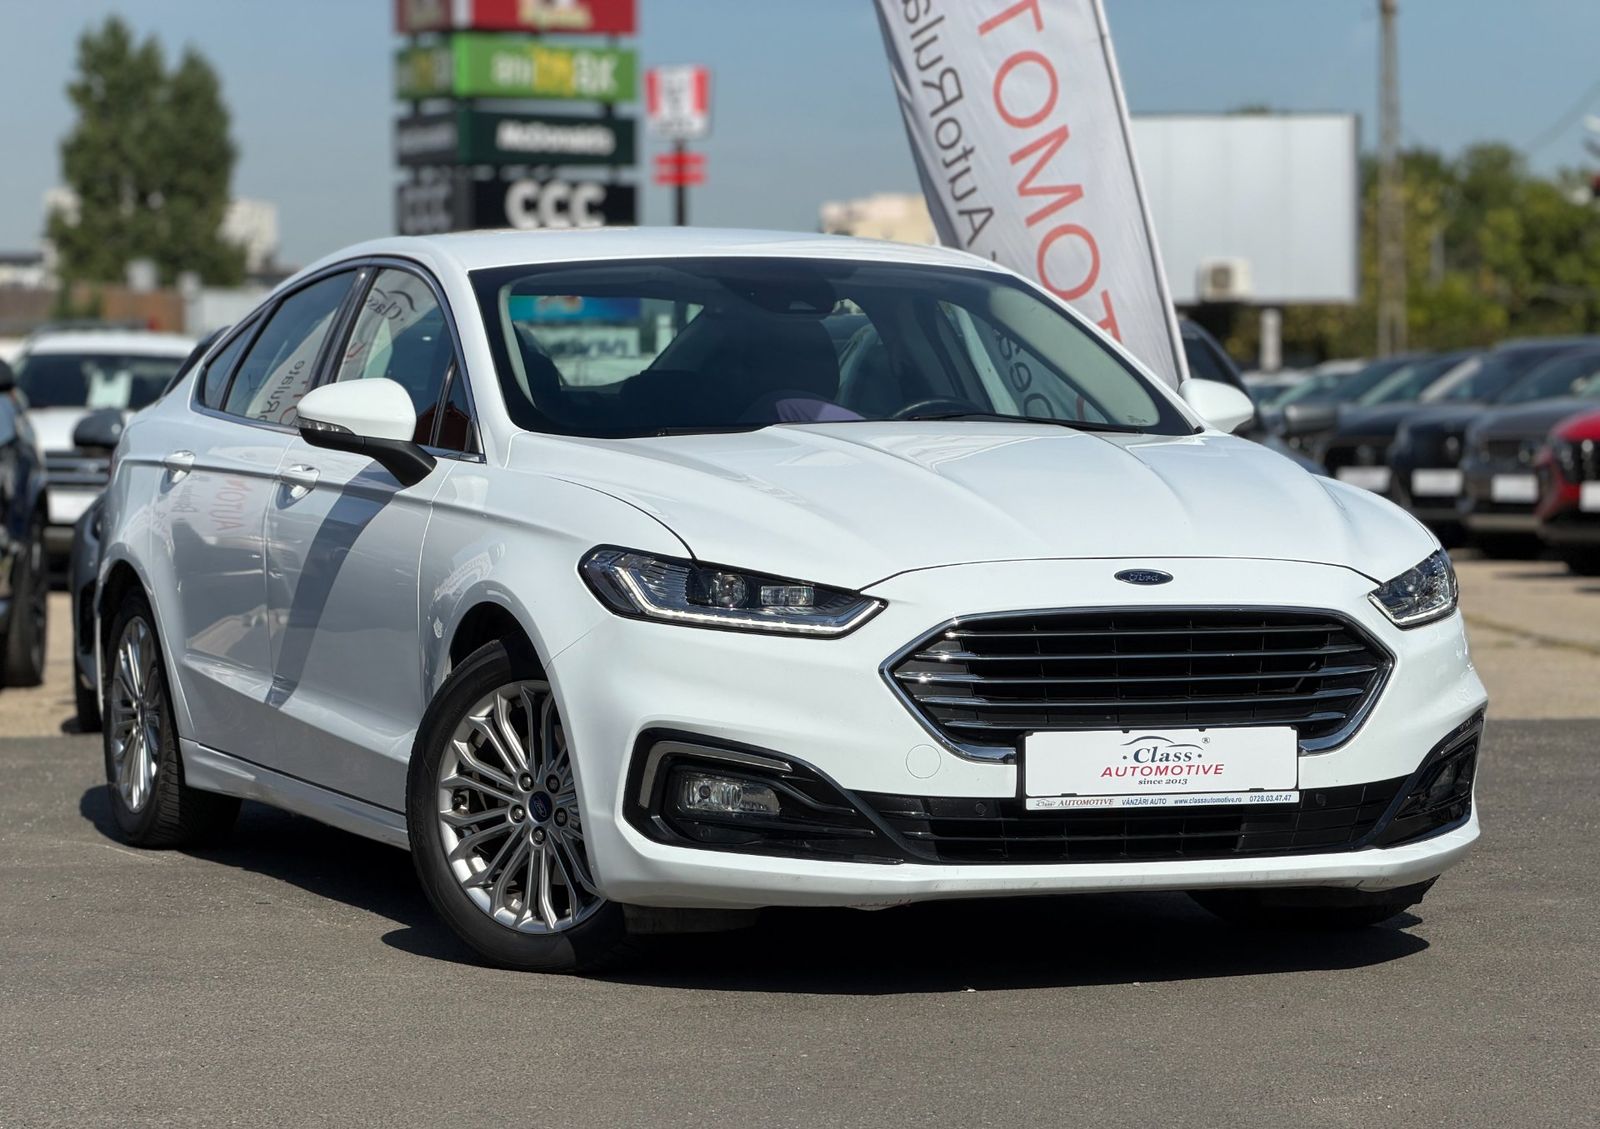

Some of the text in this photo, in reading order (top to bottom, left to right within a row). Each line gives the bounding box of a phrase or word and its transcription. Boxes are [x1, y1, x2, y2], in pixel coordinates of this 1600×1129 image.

[504, 178, 606, 229] CCC
[1133, 746, 1193, 763] Class
[1100, 763, 1225, 778] AUTOMOTIVE
[1058, 798, 1115, 807] AUTOMOTIVE
[1149, 797, 1167, 806] AUTO
